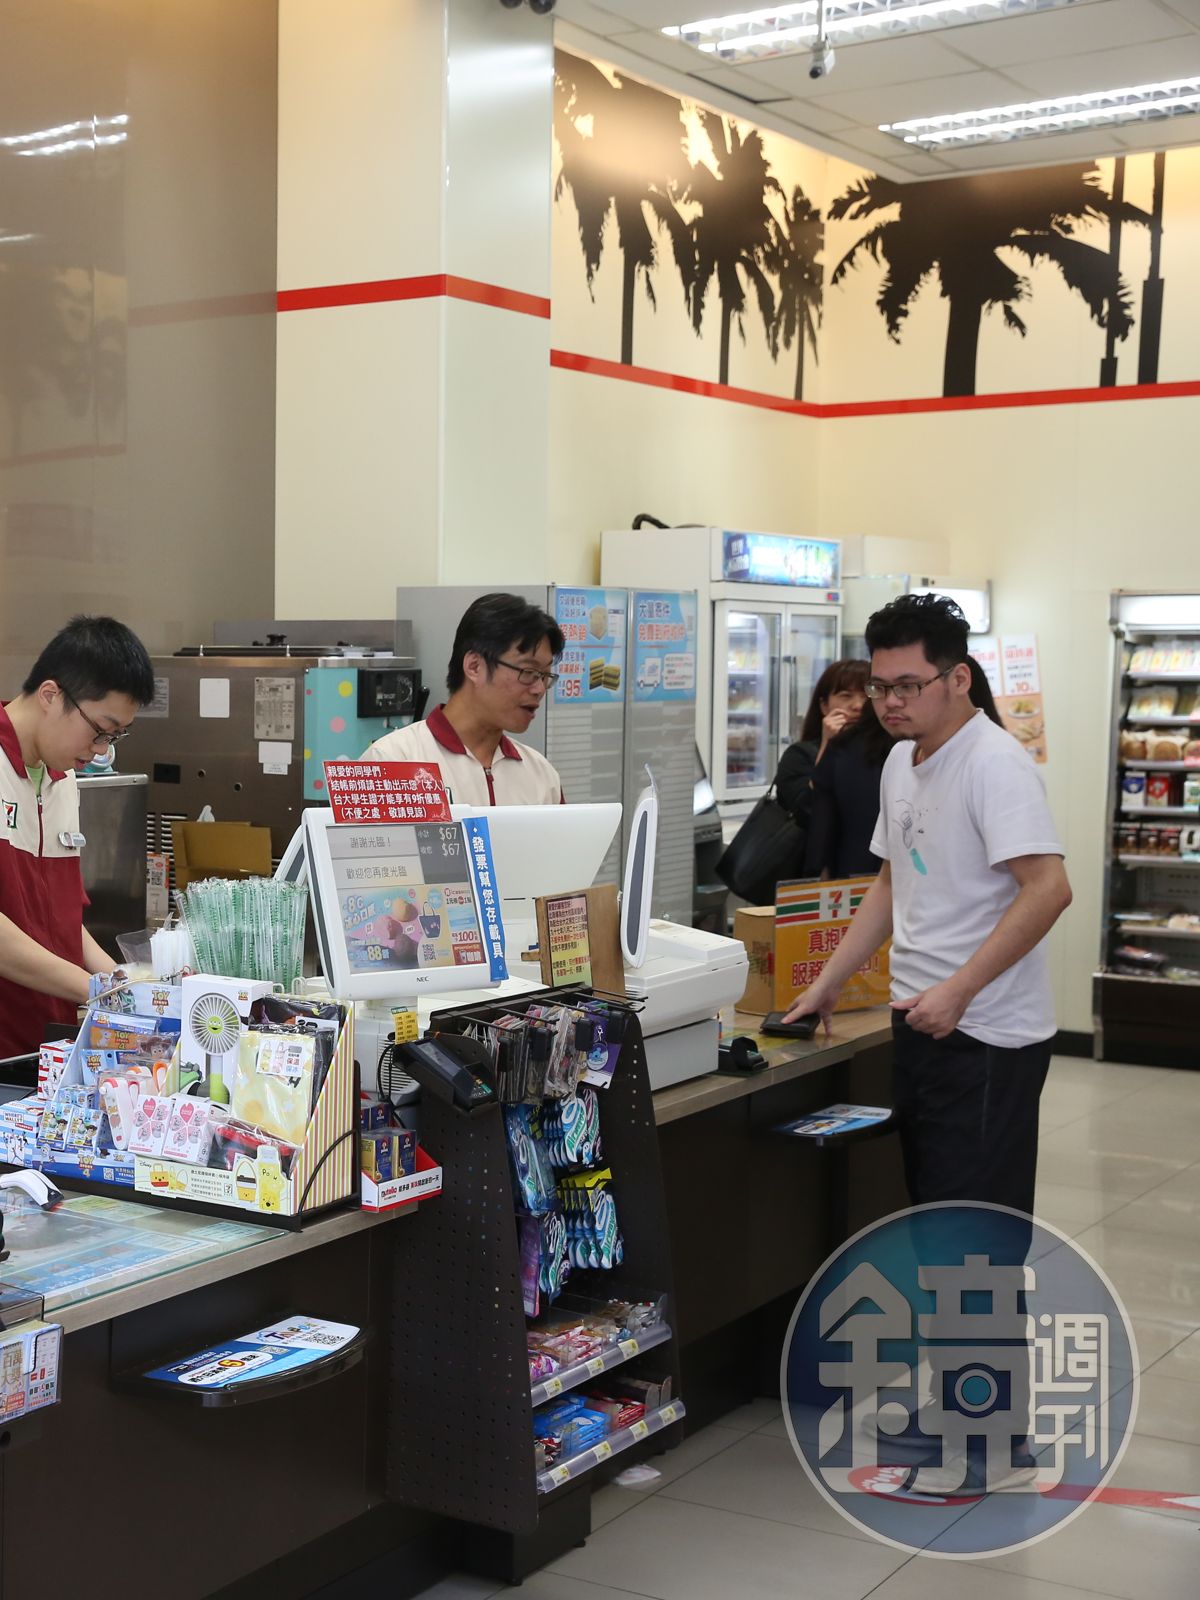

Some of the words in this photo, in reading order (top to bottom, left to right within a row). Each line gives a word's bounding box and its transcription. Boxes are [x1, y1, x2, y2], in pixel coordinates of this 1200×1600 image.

[439, 827, 458, 841] $67
[443, 843, 460, 857] $67
[346, 866, 408, 881] 歡迎您再度光臨
[151, 989, 171, 1000] TOY
[77, 1154, 95, 1163] TOY
